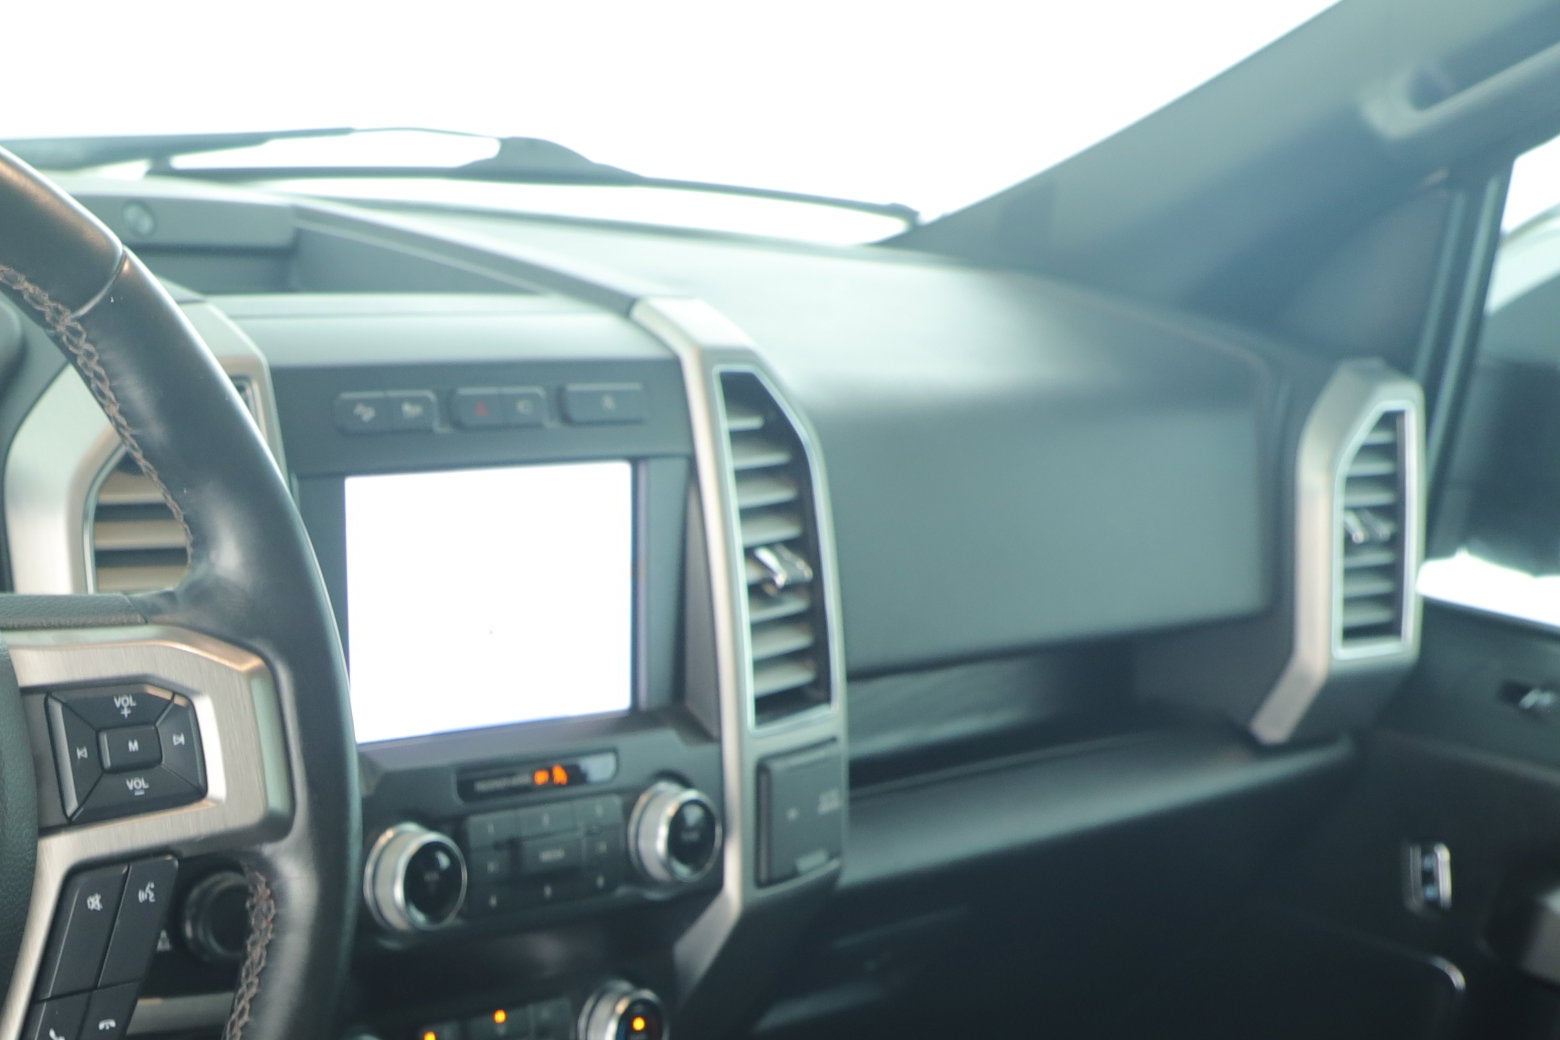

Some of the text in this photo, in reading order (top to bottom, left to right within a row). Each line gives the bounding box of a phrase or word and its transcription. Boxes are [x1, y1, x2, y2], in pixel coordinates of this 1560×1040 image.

[113, 694, 137, 709] VOL
[127, 739, 139, 752] M
[125, 776, 150, 791] VOL
